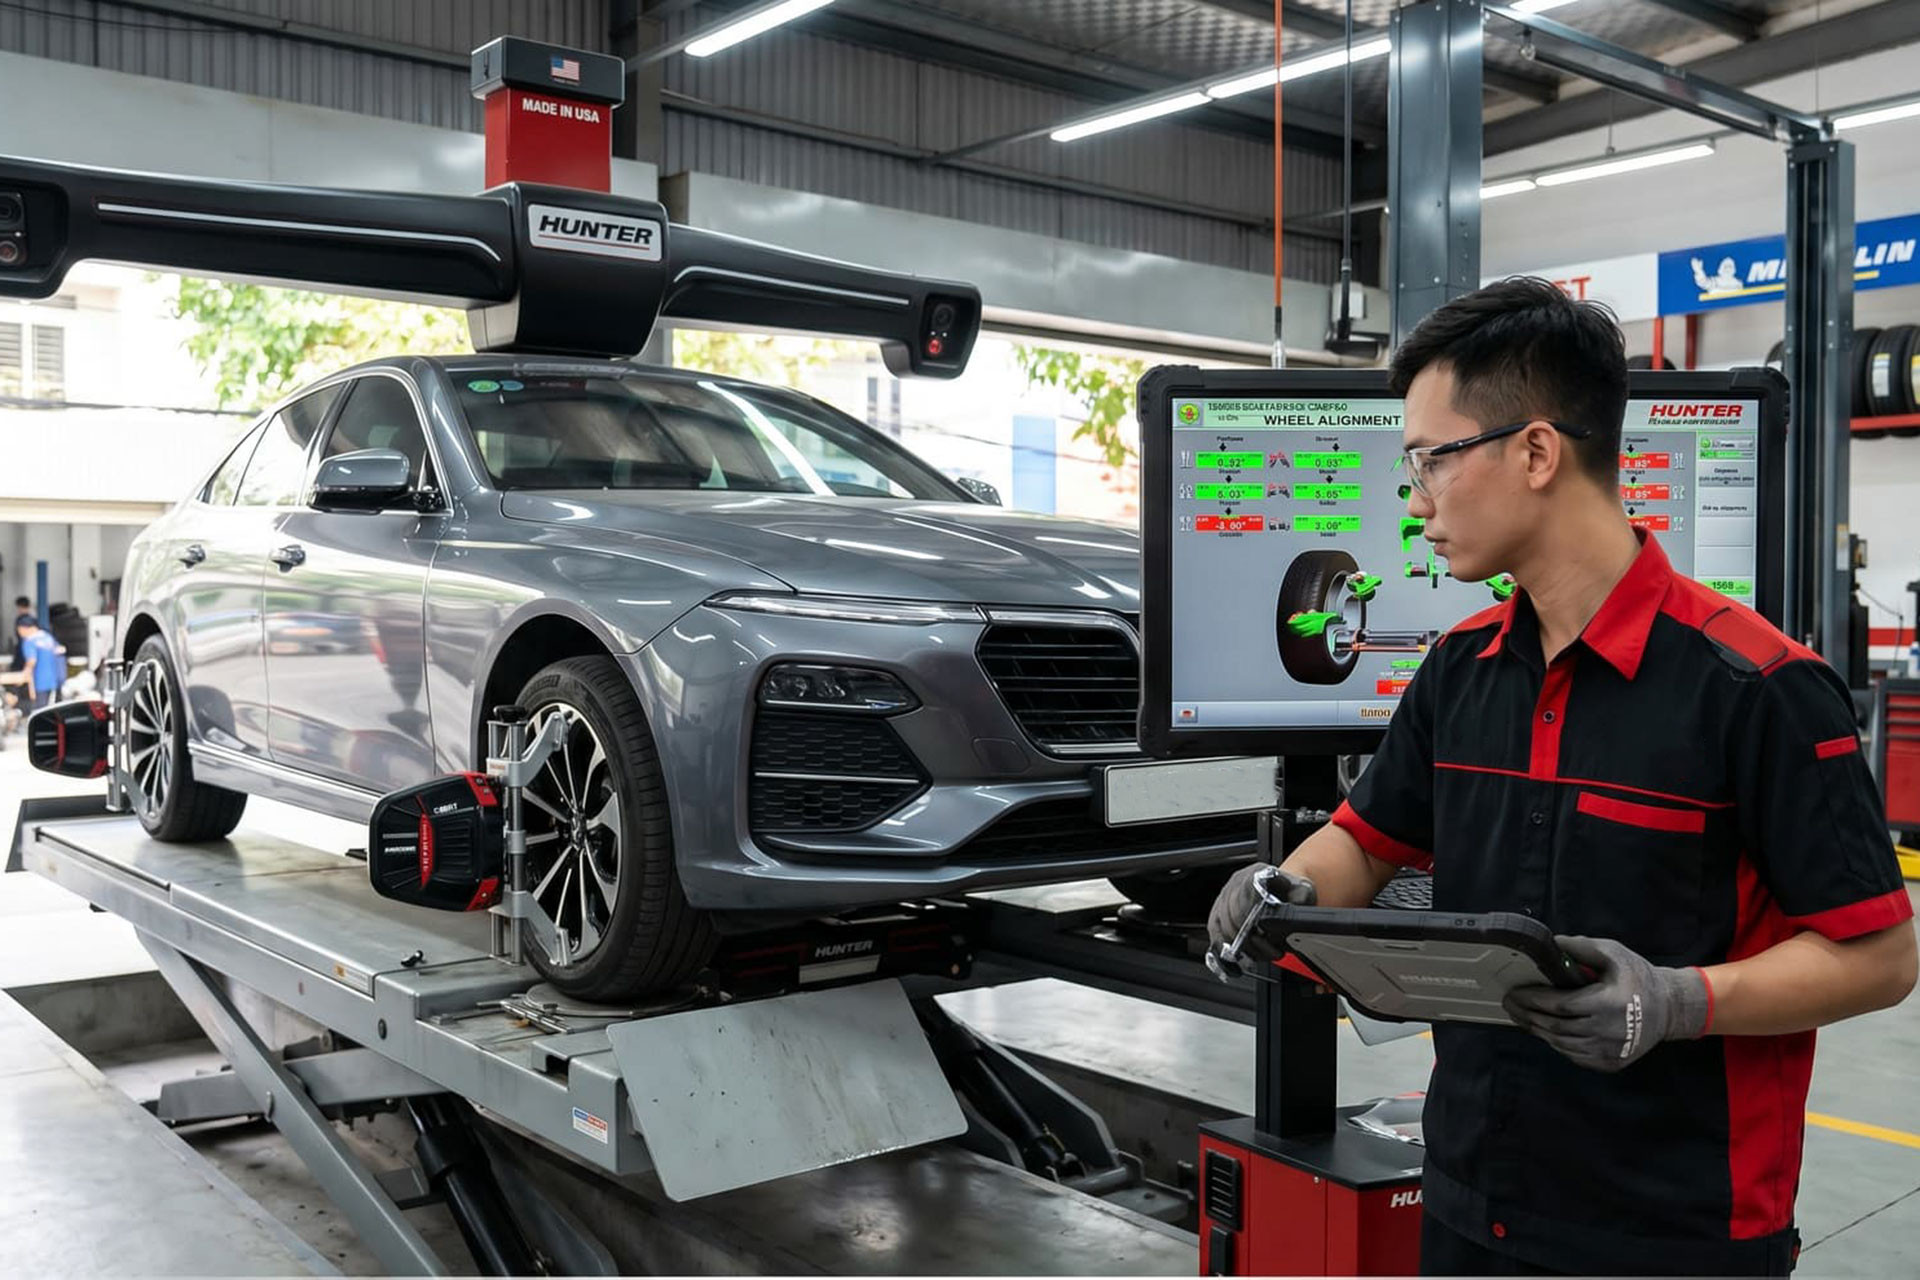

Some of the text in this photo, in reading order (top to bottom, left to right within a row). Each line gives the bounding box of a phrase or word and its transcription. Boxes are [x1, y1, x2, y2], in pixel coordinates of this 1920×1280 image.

[522, 98, 600, 123] MADE IN USA
[538, 214, 653, 245] HUNTER
[1747, 239, 1917, 283] MILIN
[1650, 404, 1743, 417] HUNTER
[1264, 415, 1402, 426] WHEEL ALIGNMENT
[815, 939, 873, 958] HUNTER
[1390, 1189, 1423, 1208] HU
